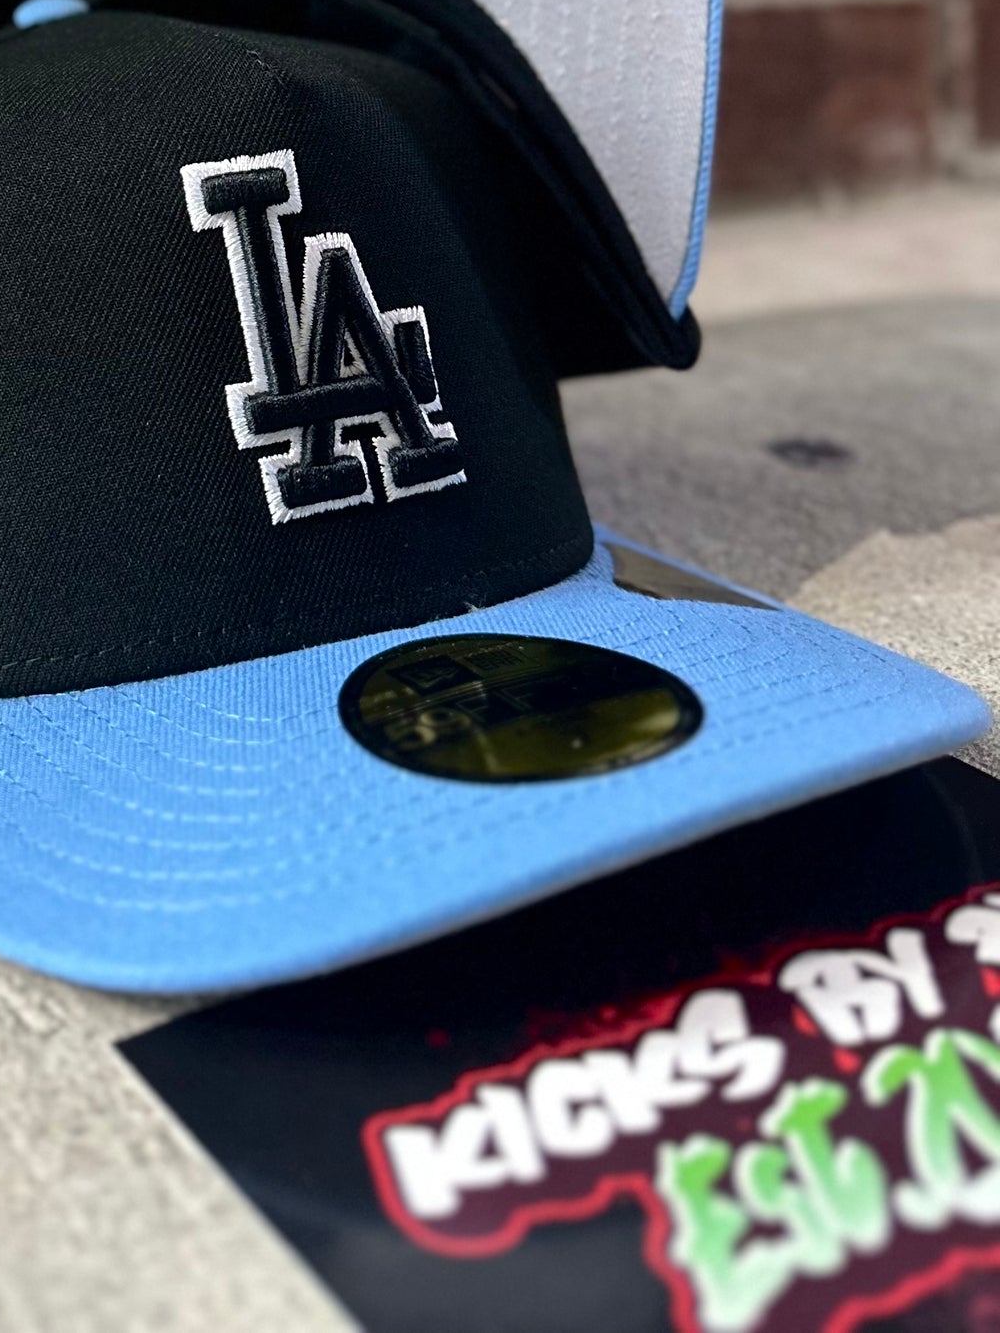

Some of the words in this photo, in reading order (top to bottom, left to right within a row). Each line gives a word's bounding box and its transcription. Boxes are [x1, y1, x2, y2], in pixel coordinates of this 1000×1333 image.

[180, 149, 468, 525] LA
[385, 988, 785, 1220] KICKS
[777, 927, 946, 1046] BY
